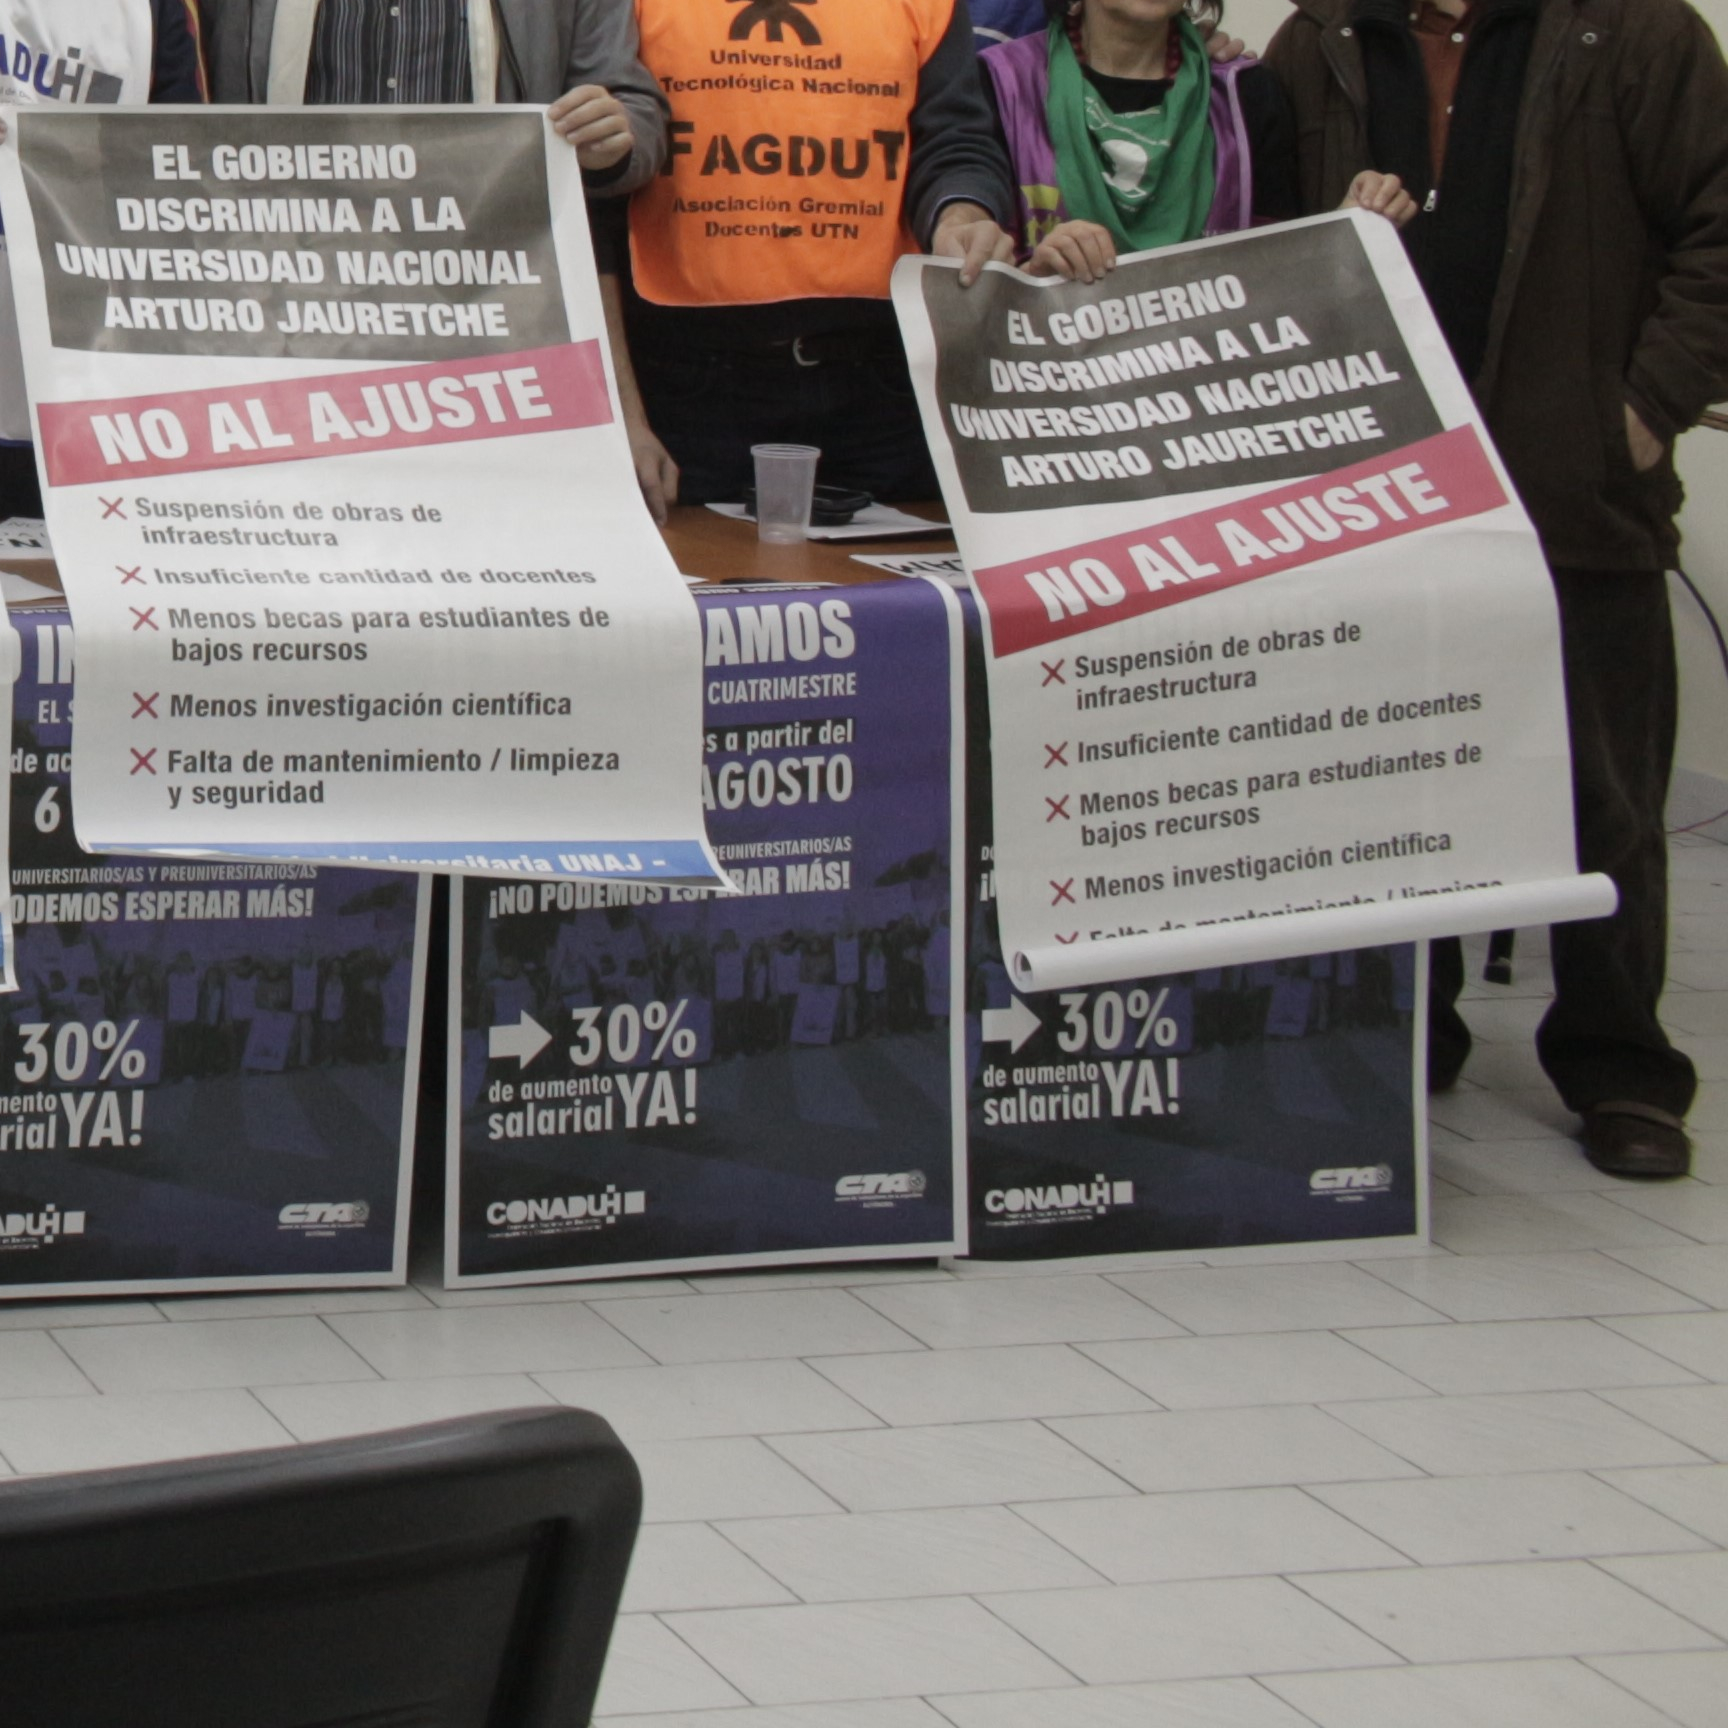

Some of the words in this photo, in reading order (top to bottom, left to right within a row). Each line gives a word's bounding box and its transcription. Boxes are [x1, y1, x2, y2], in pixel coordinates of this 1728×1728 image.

[658, 73, 795, 96] Tecnológica
[801, 77, 902, 99] Nacional
[709, 49, 843, 71] Universidad
[662, 121, 907, 182] FAGDUT
[673, 194, 792, 216] Asociación
[798, 196, 885, 218] Gremial
[810, 222, 860, 241] UTN
[1007, 310, 1047, 346] EL
[1048, 274, 1247, 346] GOBIERNO
[990, 336, 1214, 393] DISCRIMINA
[1215, 328, 1251, 361] A
[1249, 315, 1311, 354] LA
[90, 409, 190, 466] NO
[208, 399, 293, 455] AL
[314, 366, 554, 445] AJUSTE
[950, 391, 1192, 441] UNIVERSIDAD
[1194, 350, 1401, 416] NACIONAL
[1001, 445, 1153, 488] ARTURO
[1162, 405, 1385, 470] JAURETCHE
[1024, 557, 1127, 624] NO
[1143, 533, 1223, 595] AL
[1219, 462, 1452, 567] AJUSTE
[38, 699, 61, 724] EL
[707, 671, 856, 705] CUATRIMESTRE
[725, 732, 738, 752] a
[746, 721, 812, 756] partir
[818, 718, 853, 745] del
[34, 786, 61, 833] 6
[12, 868, 144, 885] UNIVERSITARIOS/AS
[148, 867, 156, 881] Y
[161, 864, 318, 883] PREUNIVERSITARIOS/AS
[786, 858, 850, 893] MÁS!
[10, 892, 120, 924] ODEMOS
[125, 889, 240, 921] ESPERAR
[246, 884, 314, 919] MÁS!
[569, 998, 697, 1066] 30%
[1057, 987, 1178, 1053] 30%
[14, 1019, 146, 1083] 30%
[983, 1064, 1006, 1088] de
[1012, 1061, 1098, 1086] aumento
[488, 1080, 513, 1103] de
[520, 1073, 613, 1100] aumento
[488, 1096, 613, 1140] salarial
[615, 1068, 697, 1129] YA!
[983, 1083, 1100, 1126] salarial
[1100, 1057, 1180, 1117] YA!
[60, 1089, 144, 1148] YA!
